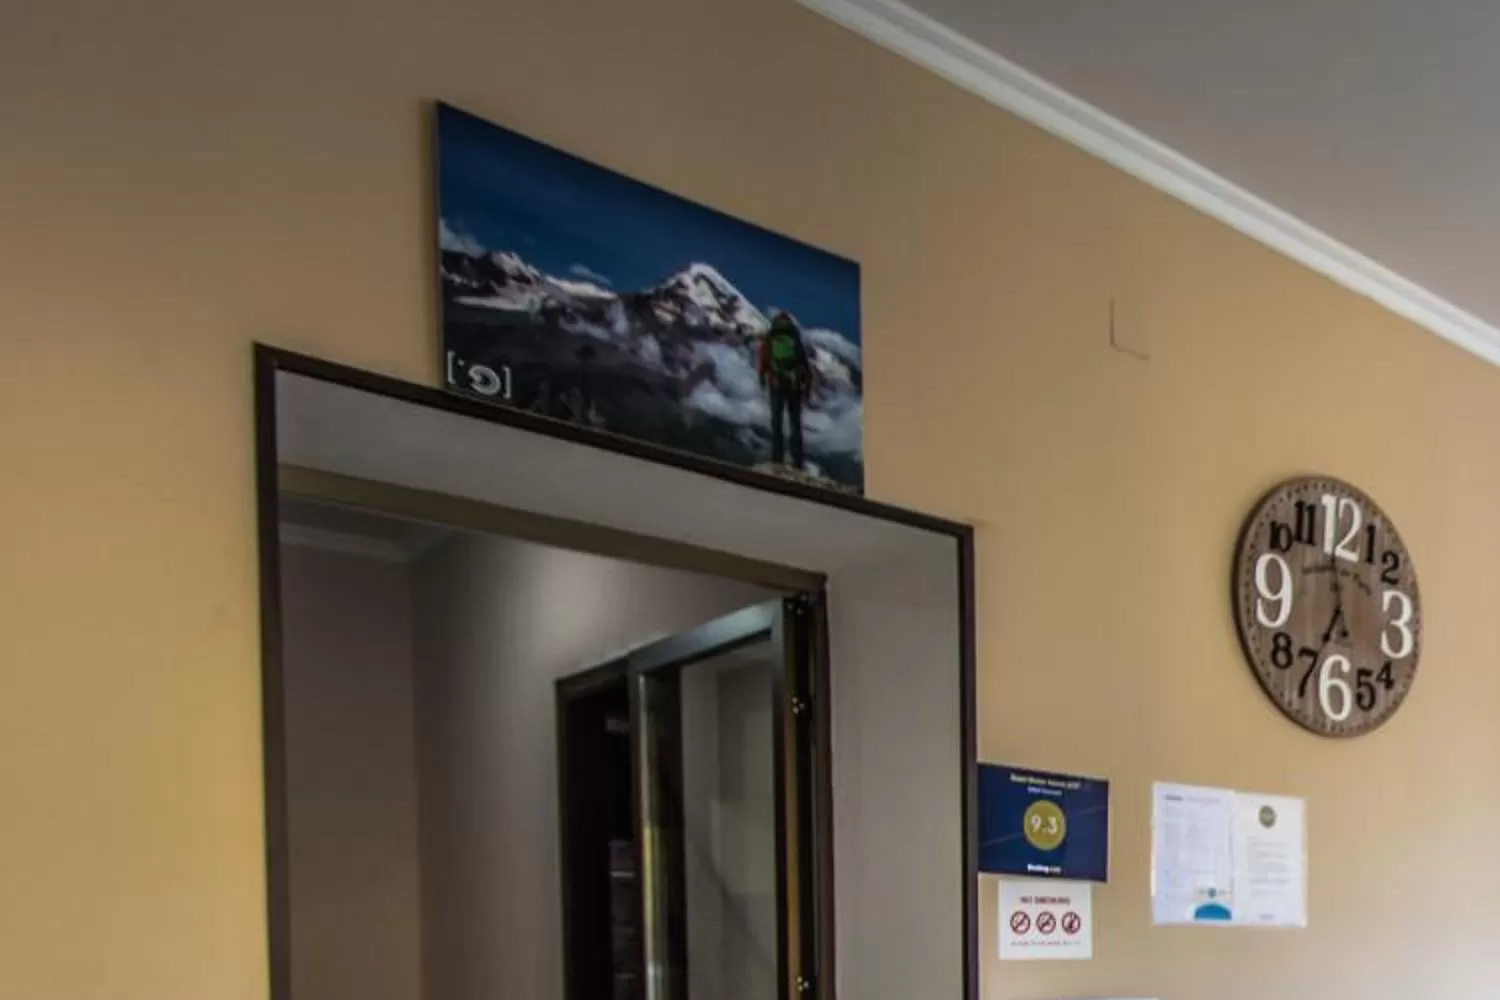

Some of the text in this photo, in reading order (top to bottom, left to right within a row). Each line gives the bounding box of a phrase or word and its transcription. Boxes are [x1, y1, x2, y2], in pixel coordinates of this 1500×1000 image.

[1269, 520, 1294, 552] 10
[1294, 500, 1317, 546] 11
[1321, 493, 1362, 563] 12
[1365, 523, 1377, 564] 1
[1255, 552, 1293, 628] 9
[1380, 551, 1399, 585] 2
[1380, 590, 1413, 659] 3
[1271, 631, 1293, 669] 8
[1298, 646, 1320, 698] 7
[1318, 653, 1352, 721] 6
[1355, 667, 1377, 712] 5
[1375, 659, 1395, 690] 4
[1030, 815, 1058, 835] 9.3
